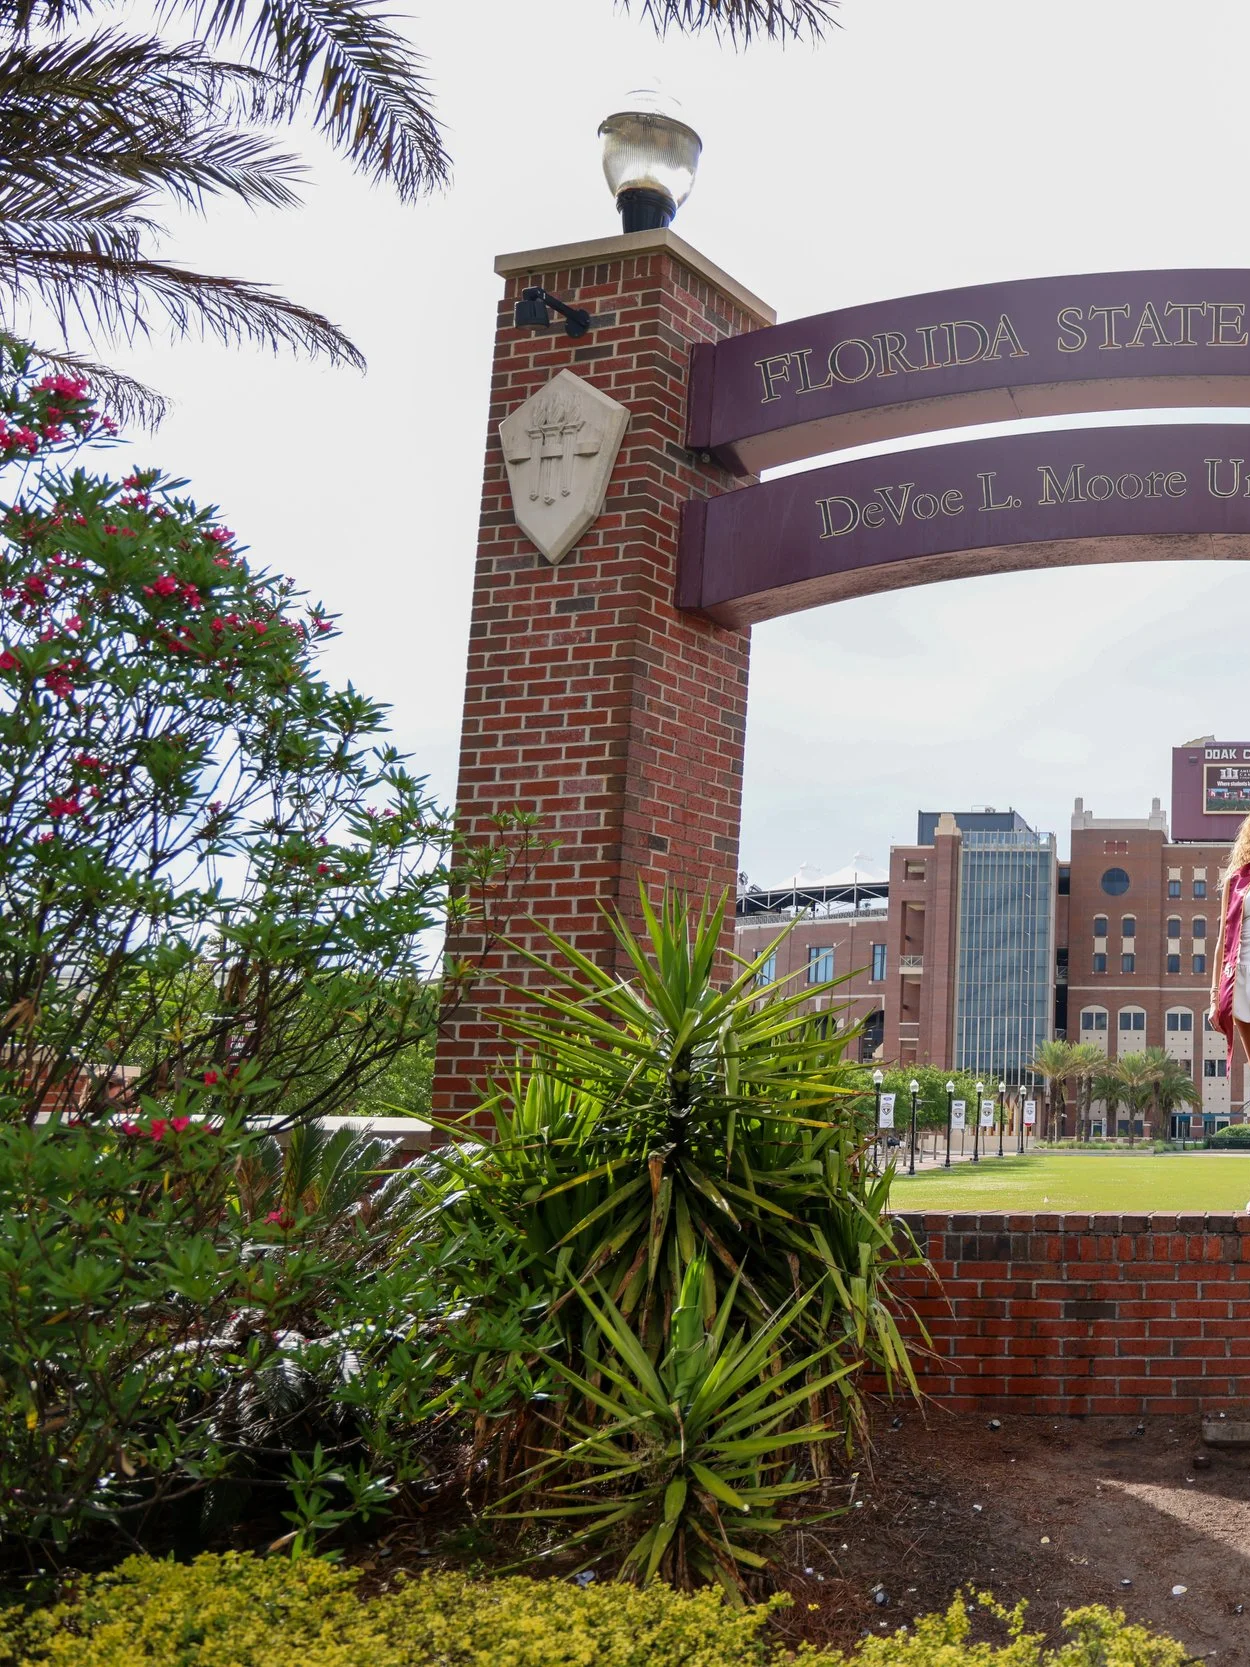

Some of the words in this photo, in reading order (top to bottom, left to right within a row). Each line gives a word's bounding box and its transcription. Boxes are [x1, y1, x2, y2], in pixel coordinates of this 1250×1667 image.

[754, 313, 1030, 403] FLORIDA
[1056, 301, 1249, 353] STATE
[815, 482, 965, 539] DeVoe
[977, 471, 1022, 512] L.
[1037, 463, 1187, 505] Moore
[1205, 749, 1237, 760] DOAK
